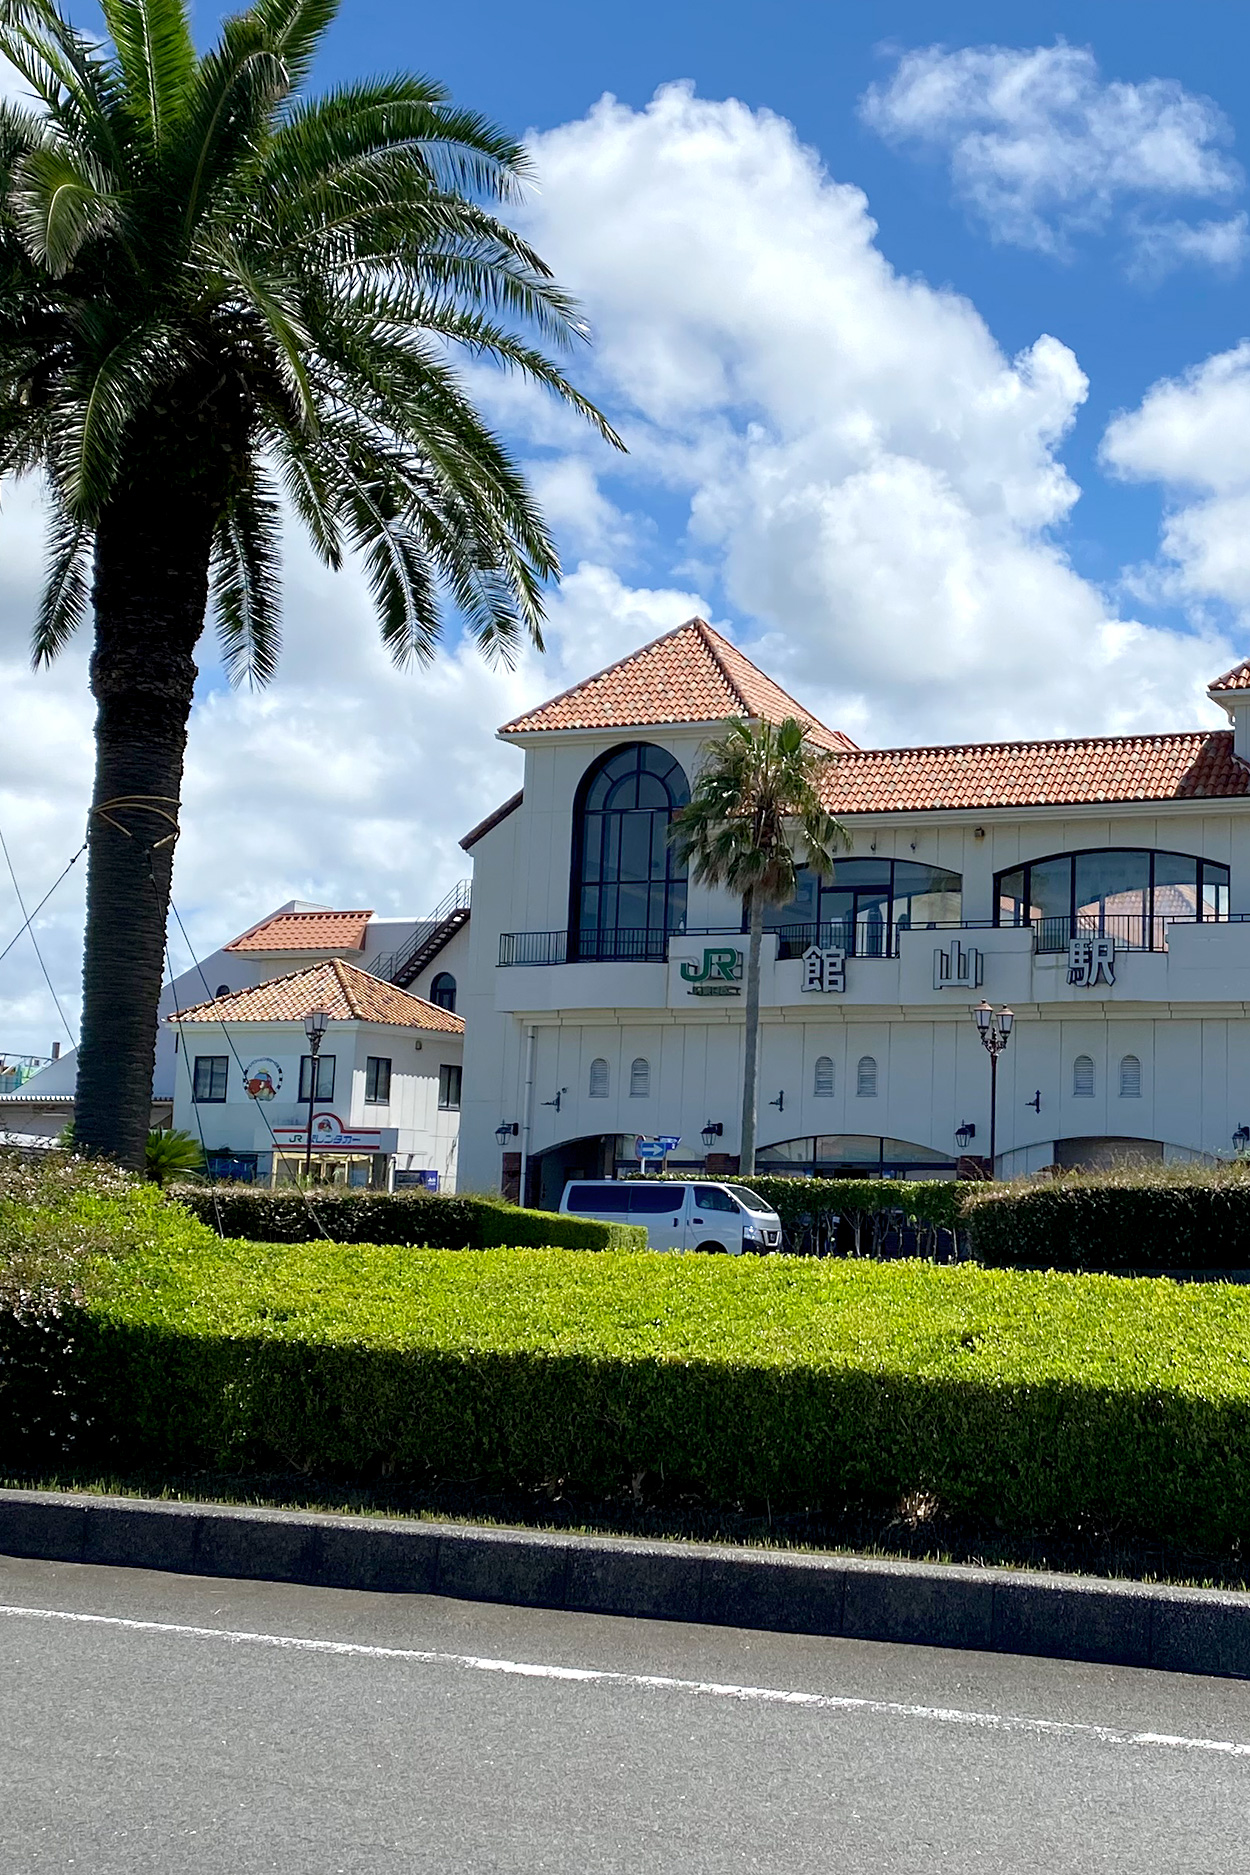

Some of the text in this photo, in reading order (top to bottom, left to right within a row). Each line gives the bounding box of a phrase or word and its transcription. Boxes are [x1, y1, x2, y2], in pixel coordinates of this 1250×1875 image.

[681, 948, 737, 982] JR
[801, 938, 1116, 993] 館山駅
[289, 1134, 303, 1143] JR
